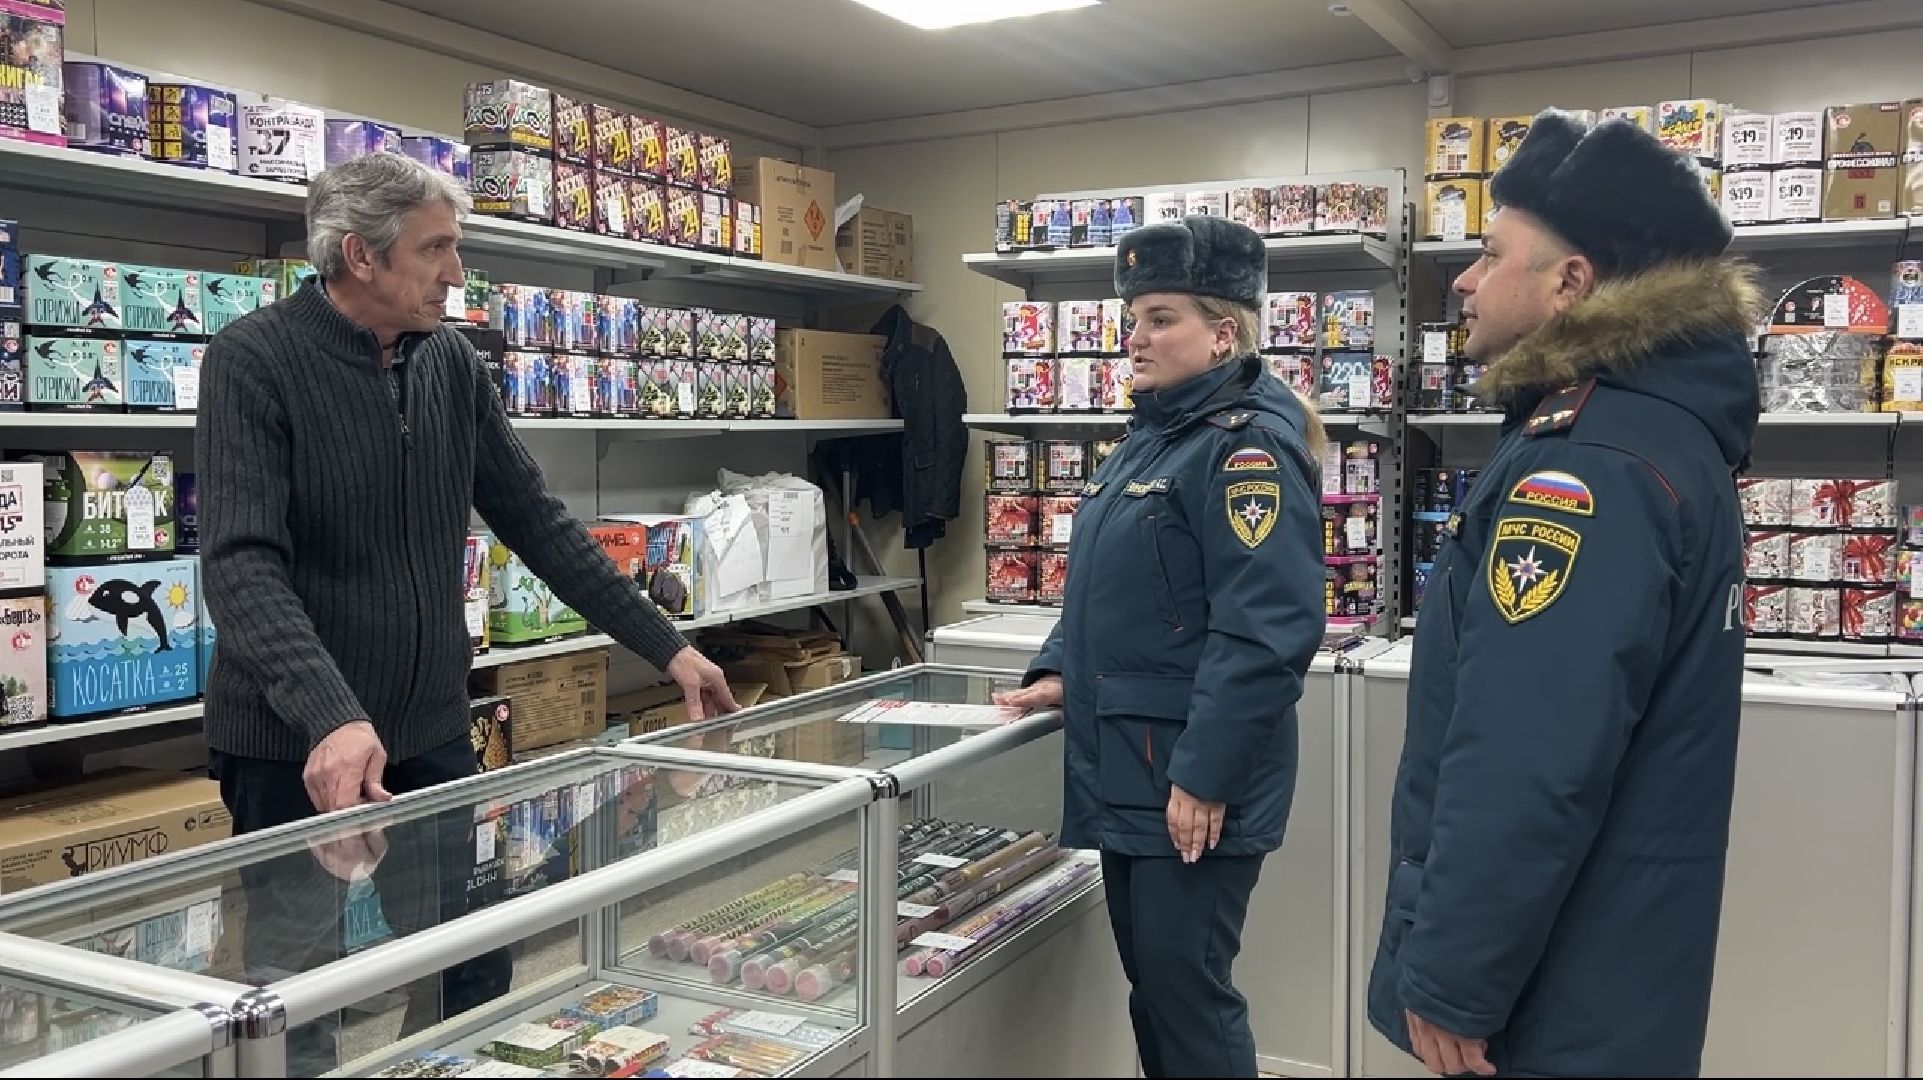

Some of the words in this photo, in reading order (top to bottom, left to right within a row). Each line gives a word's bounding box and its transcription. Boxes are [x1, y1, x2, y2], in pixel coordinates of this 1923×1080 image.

[35, 298, 80, 323] СТРИЖИ
[124, 304, 165, 330] СТРИЖИ
[36, 375, 81, 400] СТРИЖИ
[132, 379, 172, 403] СТРИЖИ
[83, 490, 168, 520] БИТК
[1526, 491, 1578, 510] РОССИЯ
[1501, 523, 1528, 536] МЧС
[1531, 524, 1576, 550] РОССИИ
[175, 662, 188, 676] 25
[73, 657, 156, 707] КОСАТКА
[65, 826, 168, 874] ТРИУМФ
